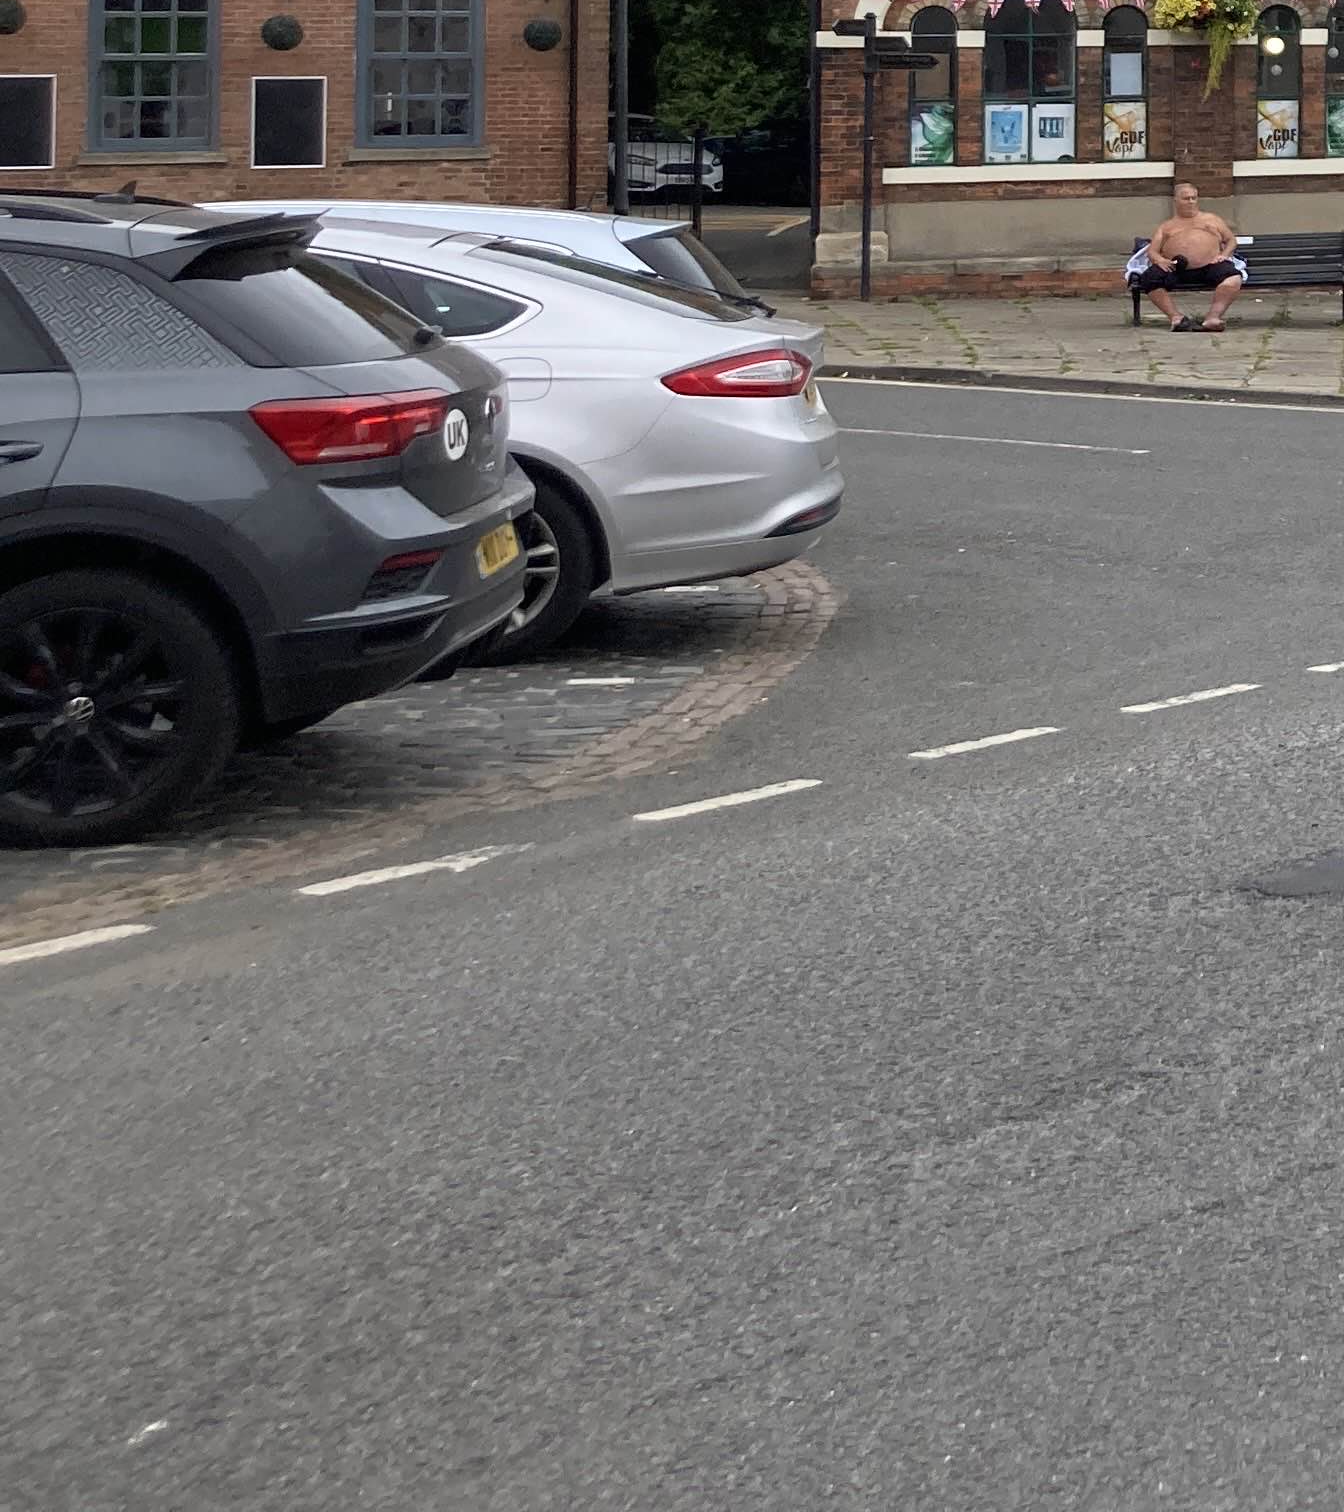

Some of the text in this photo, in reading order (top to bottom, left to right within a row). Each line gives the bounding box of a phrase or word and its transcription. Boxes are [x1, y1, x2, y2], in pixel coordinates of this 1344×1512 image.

[1120, 131, 1145, 145] GDF
[1273, 128, 1297, 143] GDF
[1104, 140, 1135, 157] Vape
[1259, 134, 1288, 156] Vape
[447, 418, 466, 450] UK
